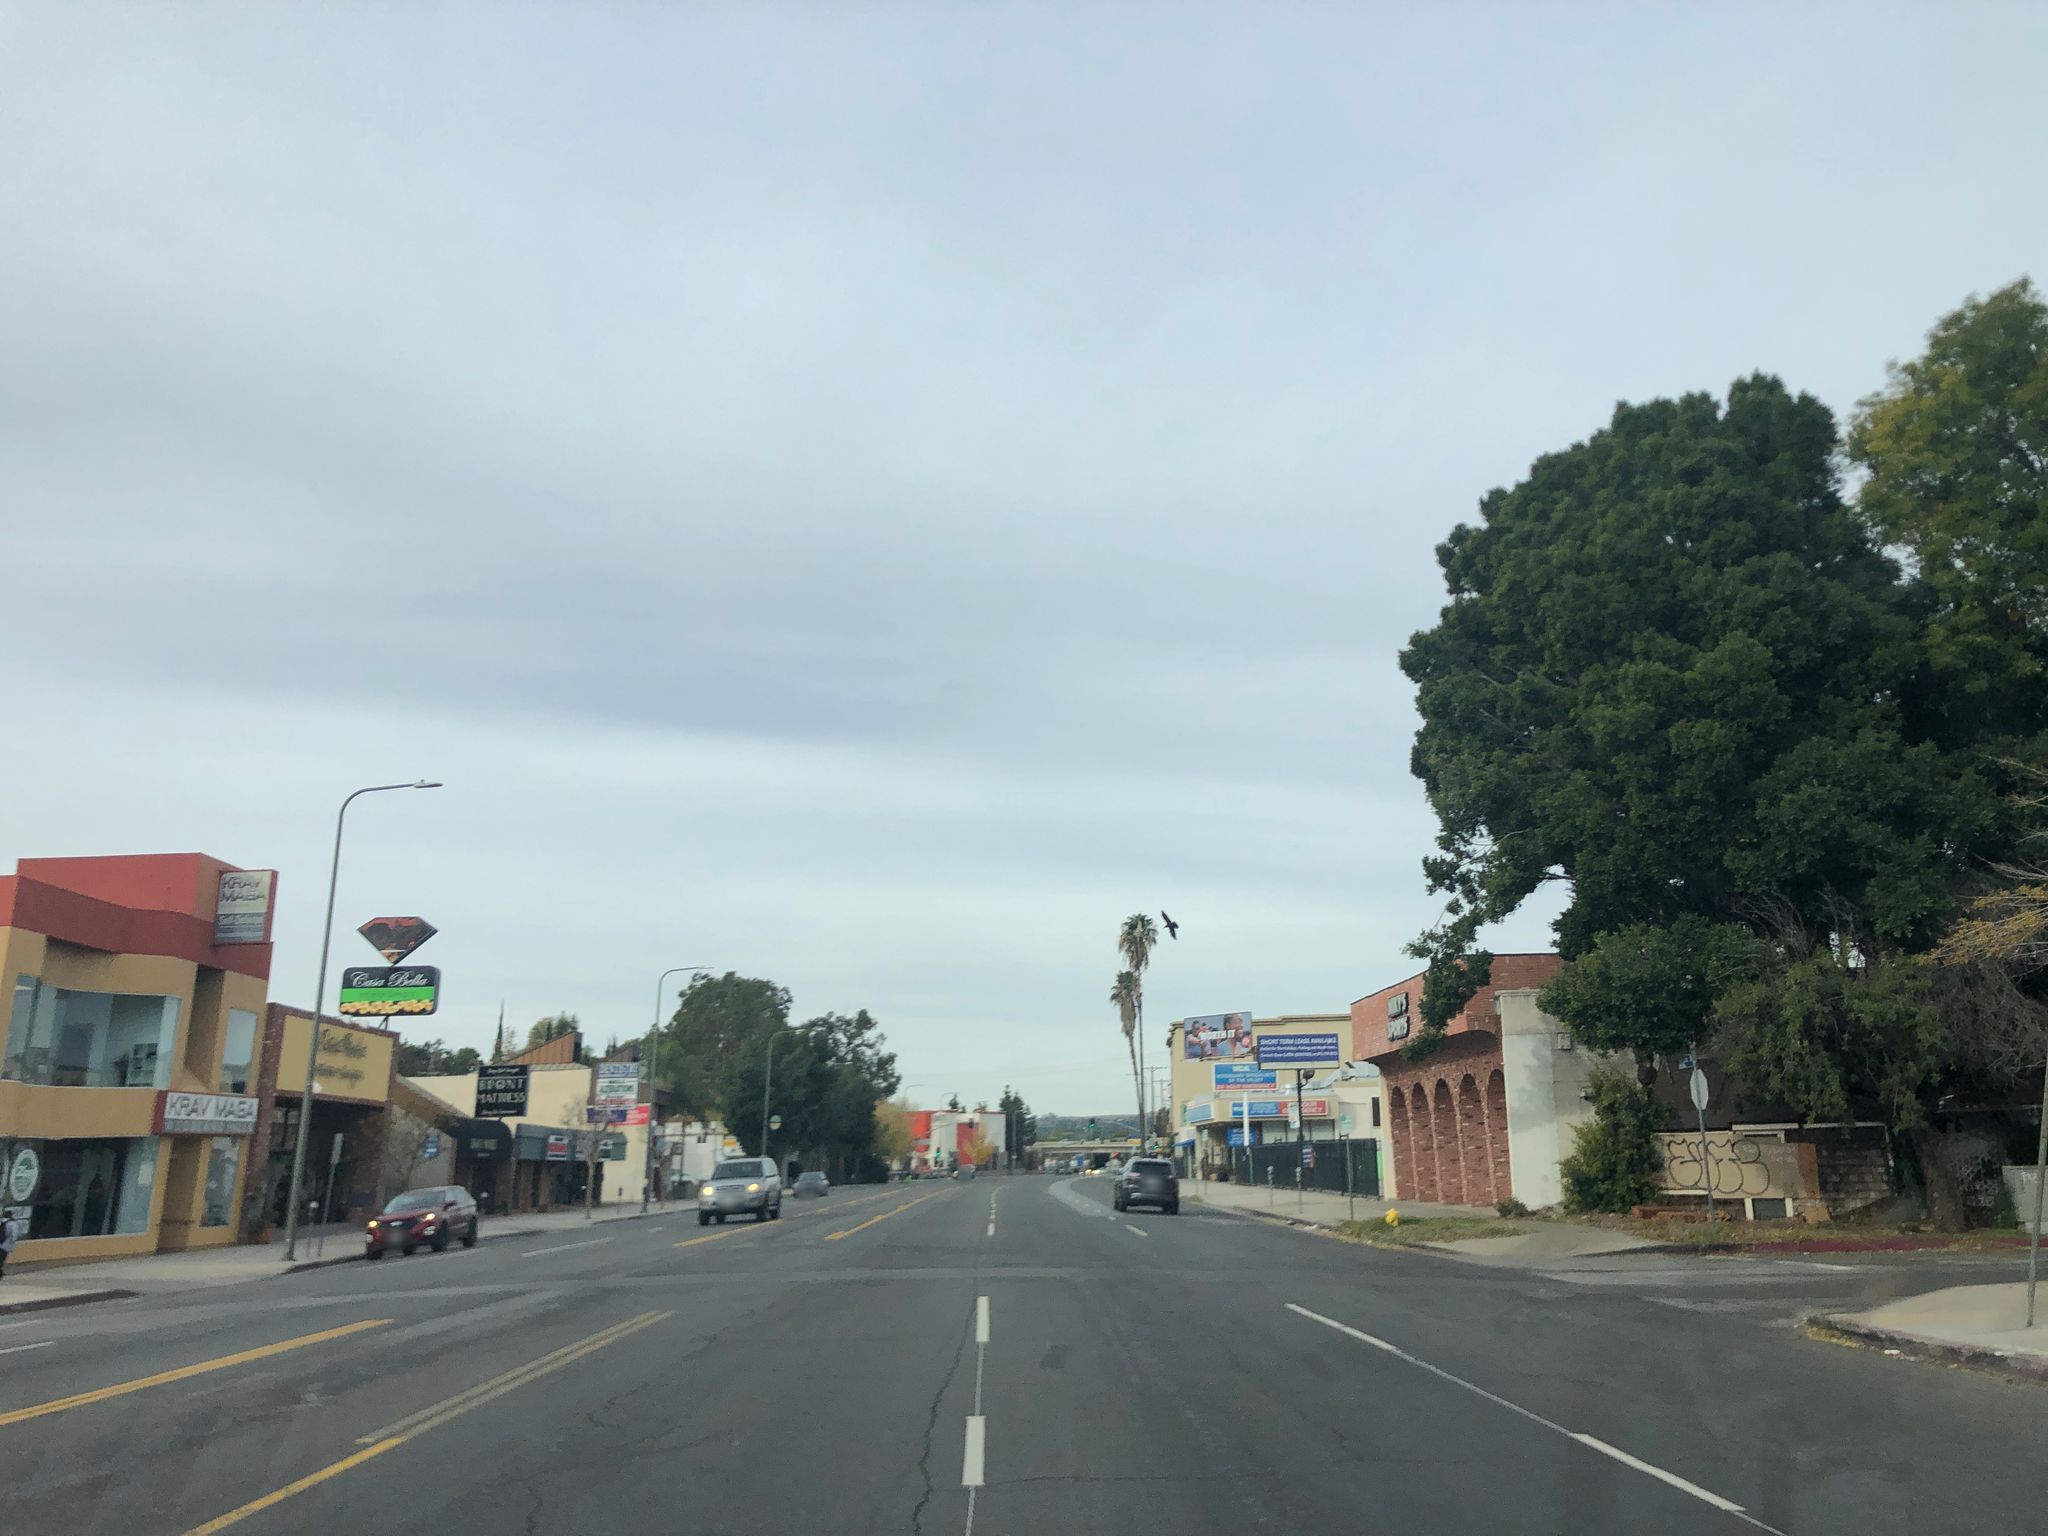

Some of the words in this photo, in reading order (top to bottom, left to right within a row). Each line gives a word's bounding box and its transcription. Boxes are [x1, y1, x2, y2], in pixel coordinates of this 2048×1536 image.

[351, 971, 386, 987] Casa
[388, 970, 429, 987] Bella
[168, 1094, 211, 1116] KRAV
[213, 1098, 254, 1119] MAGA
